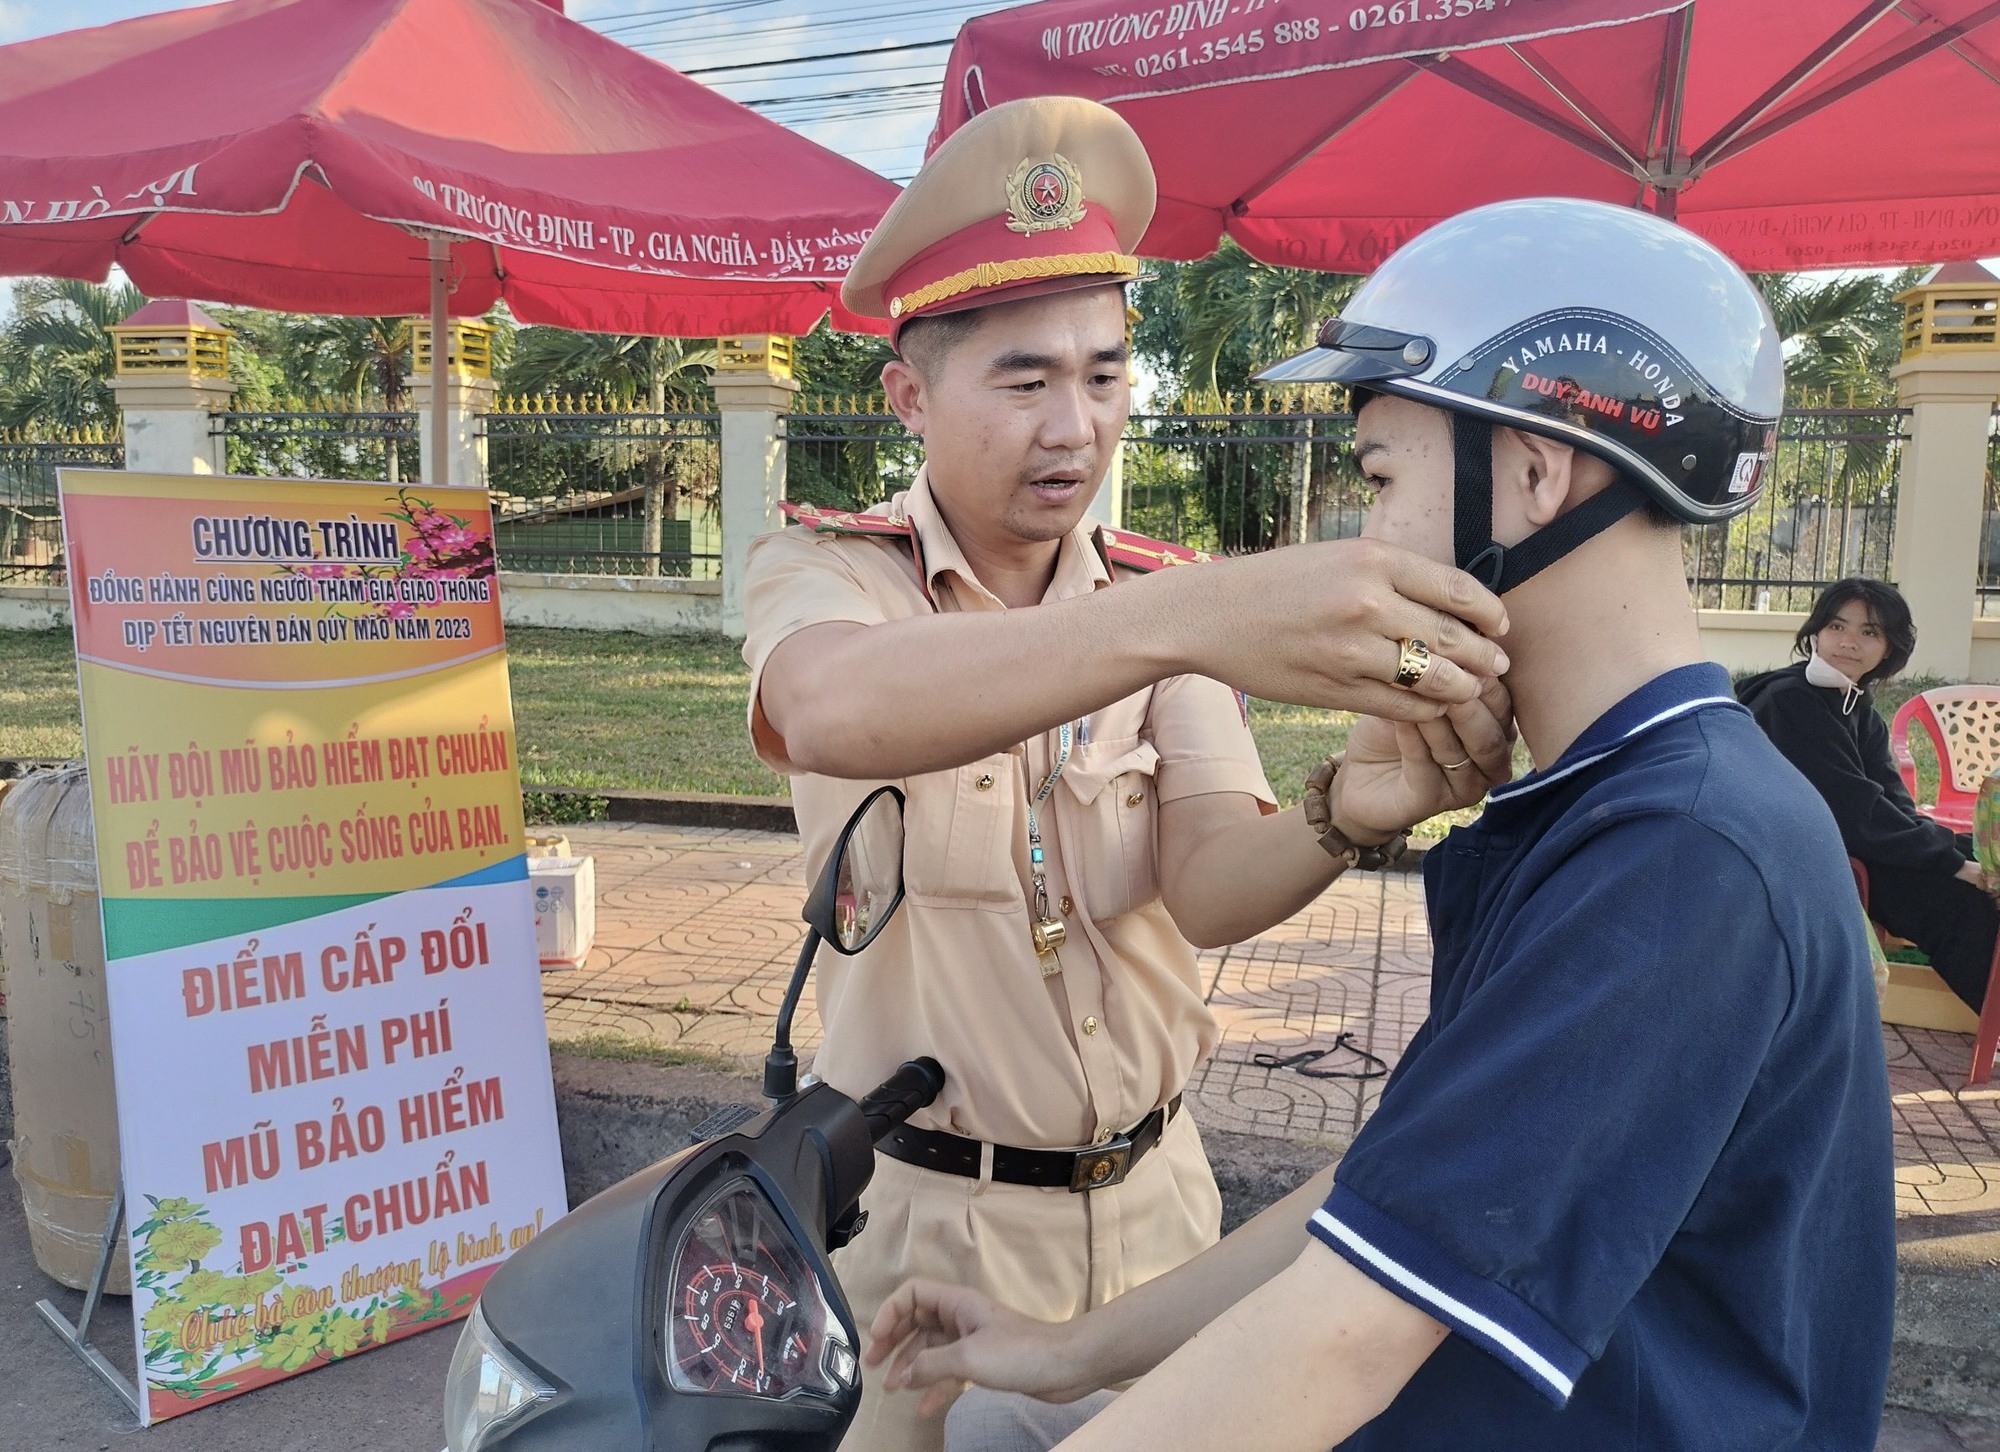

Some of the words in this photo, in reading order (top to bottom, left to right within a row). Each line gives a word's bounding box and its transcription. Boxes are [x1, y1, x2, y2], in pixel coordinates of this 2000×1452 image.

[1041, 27, 1062, 61] 90
[1066, 8, 1164, 56] TRƯƠNG
[1162, 0, 1230, 40] ĐỊNH
[1134, 29, 1265, 78] 0261.3545
[1274, 18, 1321, 45] 888
[439, 183, 534, 239] TRƯƠNG
[537, 213, 596, 252] ĐỊNH
[648, 231, 686, 261] GIA
[690, 232, 759, 267] NGHĨA
[1502, 333, 1607, 374] YAMAHA
[1629, 349, 1685, 427] HONDA
[1521, 373, 1571, 399] DUY
[1575, 389, 1625, 418] ANH
[1630, 405, 1662, 430] VŨ
[193, 515, 314, 559] CHƯƠNG
[318, 513, 400, 559] TRÌNH
[90, 569, 145, 603] ĐỒNG
[149, 573, 200, 603] HÀNH
[206, 573, 255, 603] CÙNG
[260, 573, 314, 603] NGƯỜI
[318, 579, 365, 602] THAM
[369, 579, 397, 602] GIA
[401, 579, 436, 602] GIAO
[440, 576, 490, 602] THÔNG
[124, 620, 157, 652] DỊP
[161, 612, 194, 646] TẾT
[199, 615, 272, 645] NGUYÊN
[275, 615, 314, 643] ĐÁN
[353, 615, 391, 641] MÃO
[395, 615, 431, 640] NĂM
[434, 617, 472, 640] 2023
[107, 745, 160, 805] HÃY
[168, 741, 215, 808] ĐỘI
[219, 739, 262, 795] MŨ
[266, 729, 318, 790] BẢO
[322, 722, 384, 786] HIỂM
[388, 736, 430, 789] ĐẠT
[436, 714, 508, 776] CHUẨN
[126, 818, 164, 890] ĐỂ
[168, 819, 224, 885] BẢO
[228, 819, 263, 886] VỆ
[267, 813, 334, 879] CUỘC
[338, 801, 404, 865] SỐNG
[408, 797, 454, 856] CỦA
[457, 804, 510, 857] BẠN.
[182, 938, 307, 1018] ĐIỂM
[320, 922, 407, 993] CẤP
[420, 906, 490, 976] ĐỔI
[246, 1013, 369, 1094] MIỄN
[380, 998, 453, 1065] PHÍ
[201, 1119, 281, 1194] MŨ
[294, 1096, 387, 1171] BẢO
[398, 1066, 505, 1145] HIỂM
[239, 1203, 329, 1276] ĐẠT
[344, 1149, 491, 1243] CHUẨN
[181, 1307, 249, 1353] Chúc
[254, 1292, 288, 1331] bà
[291, 1285, 336, 1319] con
[341, 1262, 424, 1300] thượng
[429, 1239, 453, 1280] lộ
[456, 1221, 506, 1267] bình
[713, 1277, 722, 1293] 100
[712, 1332, 722, 1349] 40
[738, 1357, 747, 1376] 20
